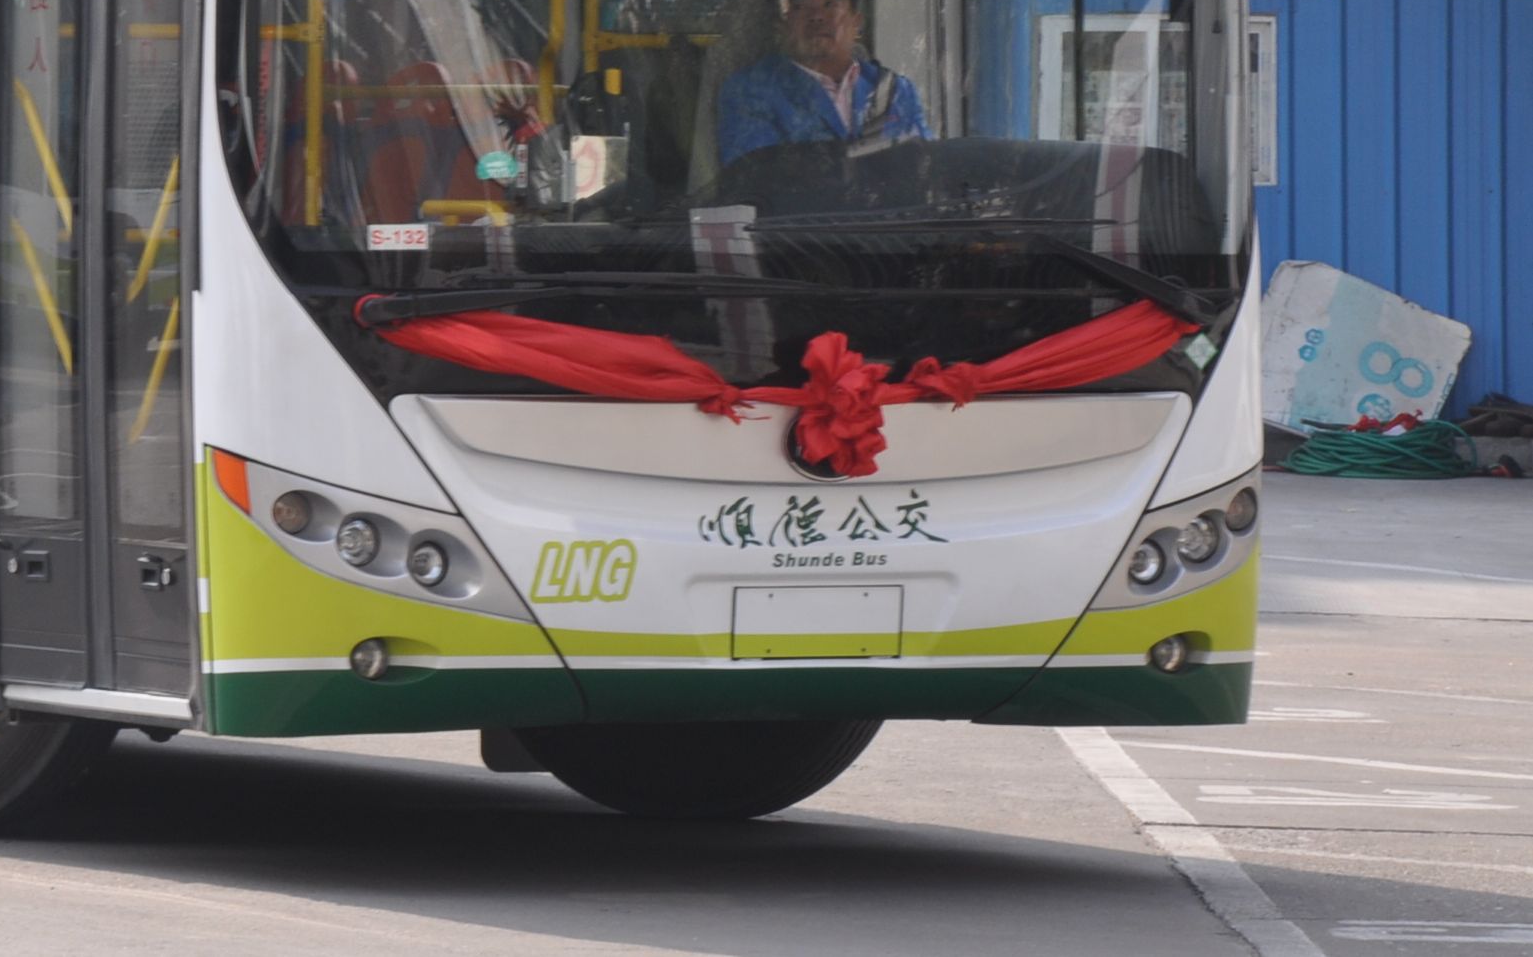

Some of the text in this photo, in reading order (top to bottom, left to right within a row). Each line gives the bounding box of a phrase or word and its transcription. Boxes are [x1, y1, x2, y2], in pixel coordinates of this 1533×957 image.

[371, 229, 427, 245] S-132
[772, 551, 888, 568] Shunde Bus
[531, 538, 638, 604] LNG
